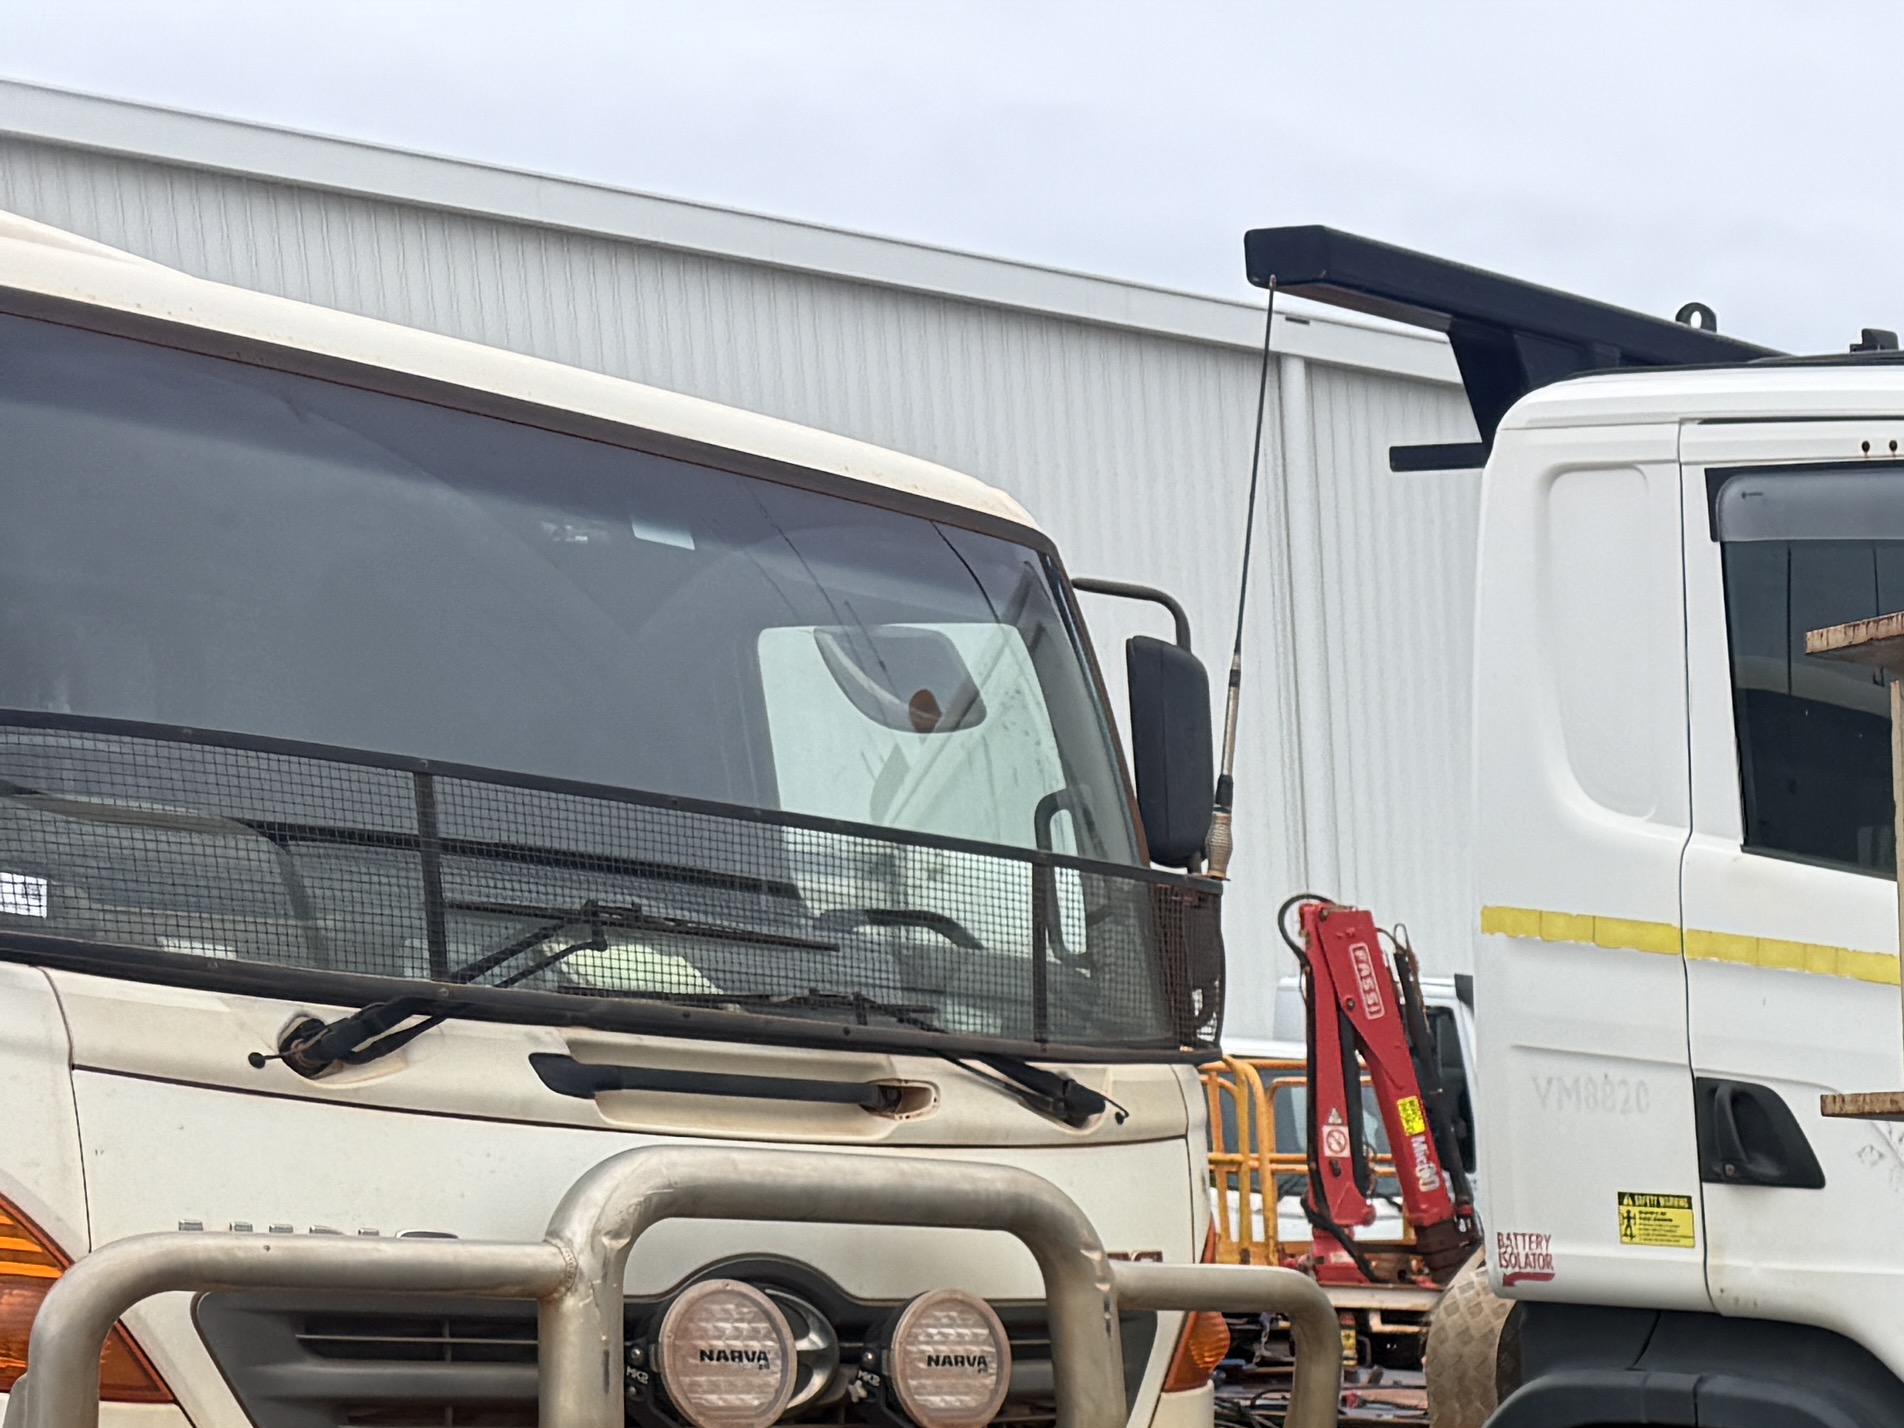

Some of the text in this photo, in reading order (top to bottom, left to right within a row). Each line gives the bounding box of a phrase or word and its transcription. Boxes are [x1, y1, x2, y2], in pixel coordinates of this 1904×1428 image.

[1354, 949, 1381, 1013] FASSI
[1497, 1232, 1552, 1251] BATTERY
[1499, 1251, 1554, 1271] ISOLATOR
[699, 1348, 770, 1363] NARVA
[926, 1354, 988, 1368] NARVA
